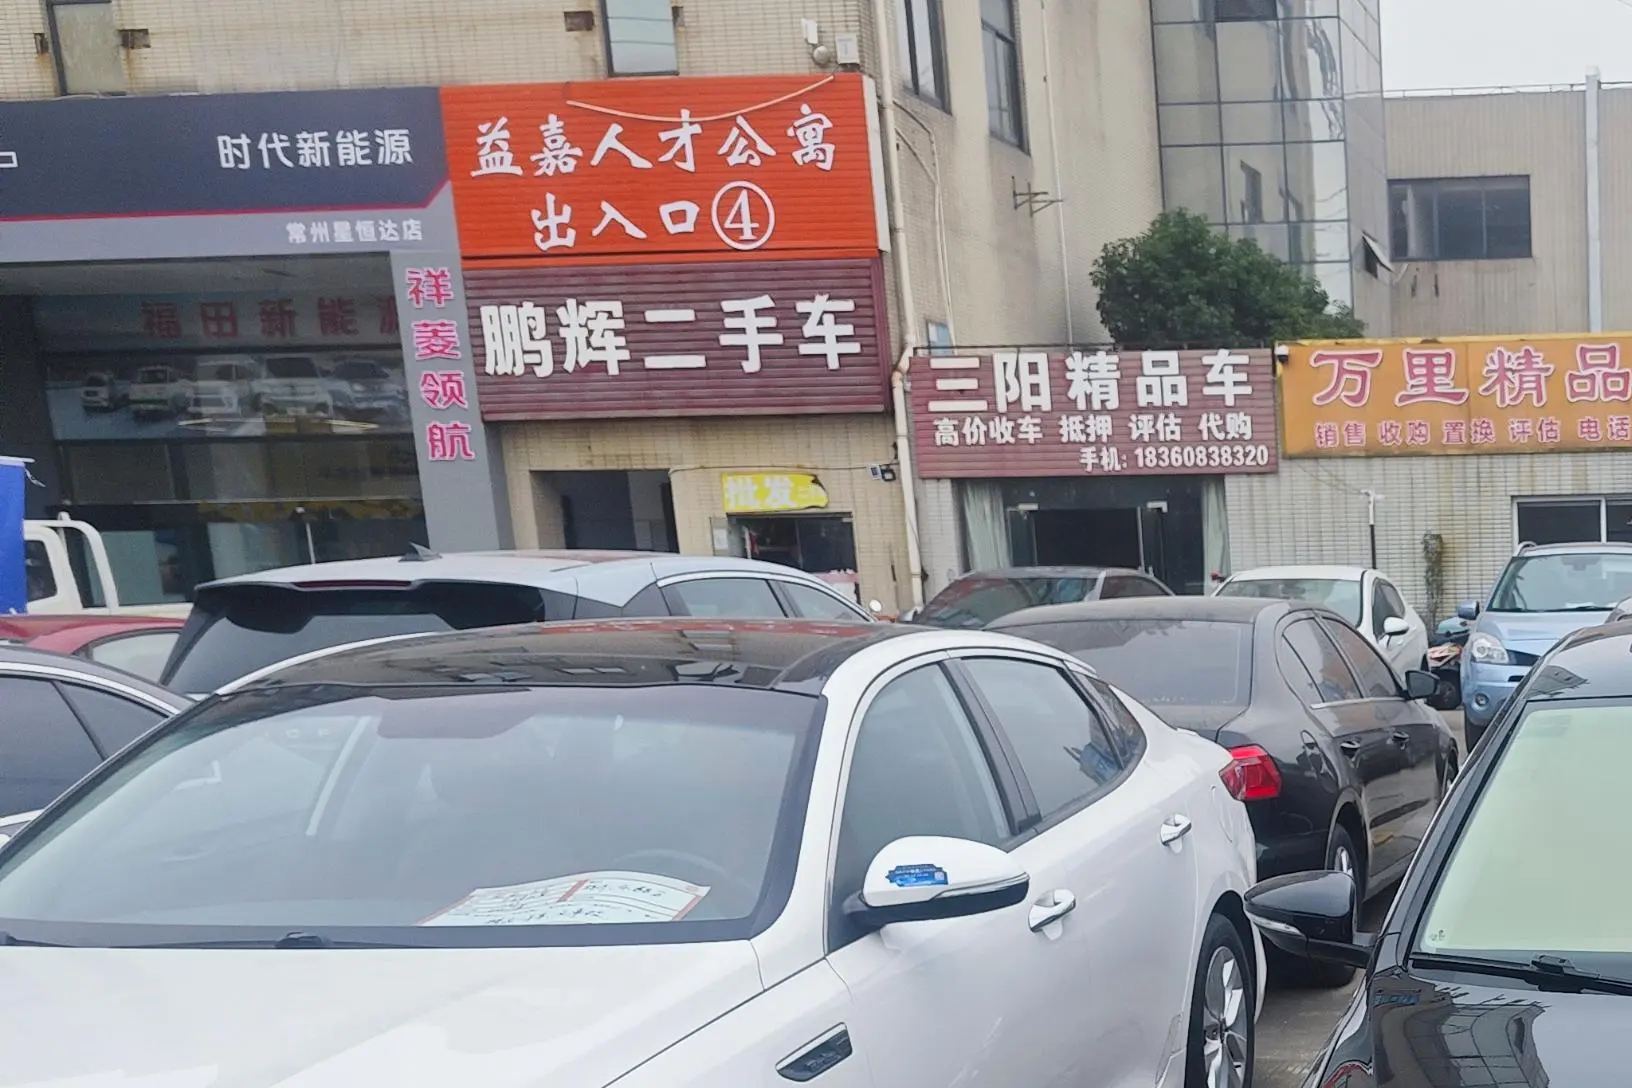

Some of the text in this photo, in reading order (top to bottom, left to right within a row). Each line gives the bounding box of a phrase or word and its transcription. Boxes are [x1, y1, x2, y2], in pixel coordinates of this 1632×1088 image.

[218, 129, 413, 171] 时代新能源
[471, 104, 837, 177] 益嘉人才公寓
[286, 219, 423, 244] 常州星恒达店
[481, 294, 862, 378] 鹏辉二手车
[406, 266, 476, 461] 祥菱领航
[928, 349, 1252, 413] 三阳精品车
[933, 412, 1252, 447] 高价收车 抵押 评估 代购
[1314, 420, 1366, 449] 销售
[1378, 419, 1431, 446] 收购
[1442, 418, 1494, 445] 置换
[1510, 416, 1562, 444] 评估
[1135, 445, 1268, 467] 18360838320
